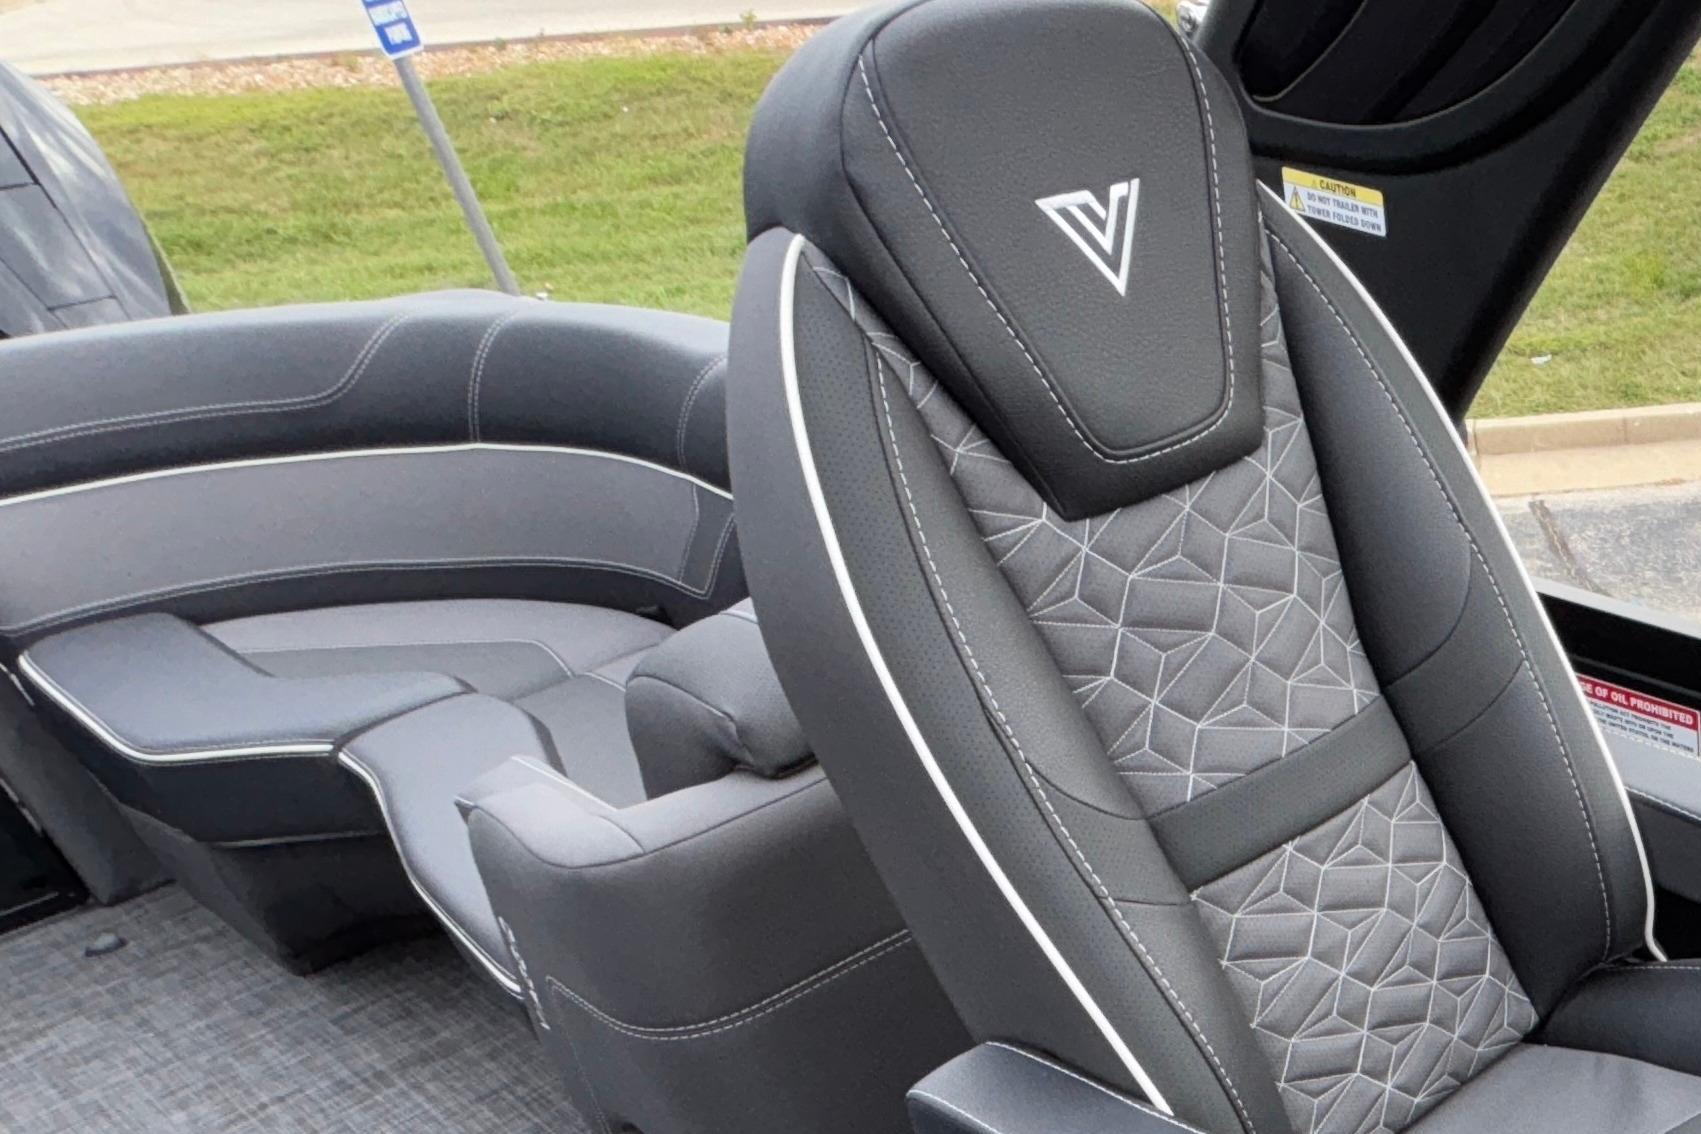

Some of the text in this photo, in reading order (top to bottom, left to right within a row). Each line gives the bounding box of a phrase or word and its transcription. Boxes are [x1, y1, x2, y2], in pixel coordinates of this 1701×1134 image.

[1319, 179, 1357, 197] CAUTION
[1307, 192, 1378, 218] DO NOT TRAILER WITH
[1307, 205, 1382, 233] TOWER FOLDED DOWN
[1595, 686, 1608, 698] OF
[1610, 691, 1628, 706] OIL
[1629, 697, 1694, 725] PROHIBITED
